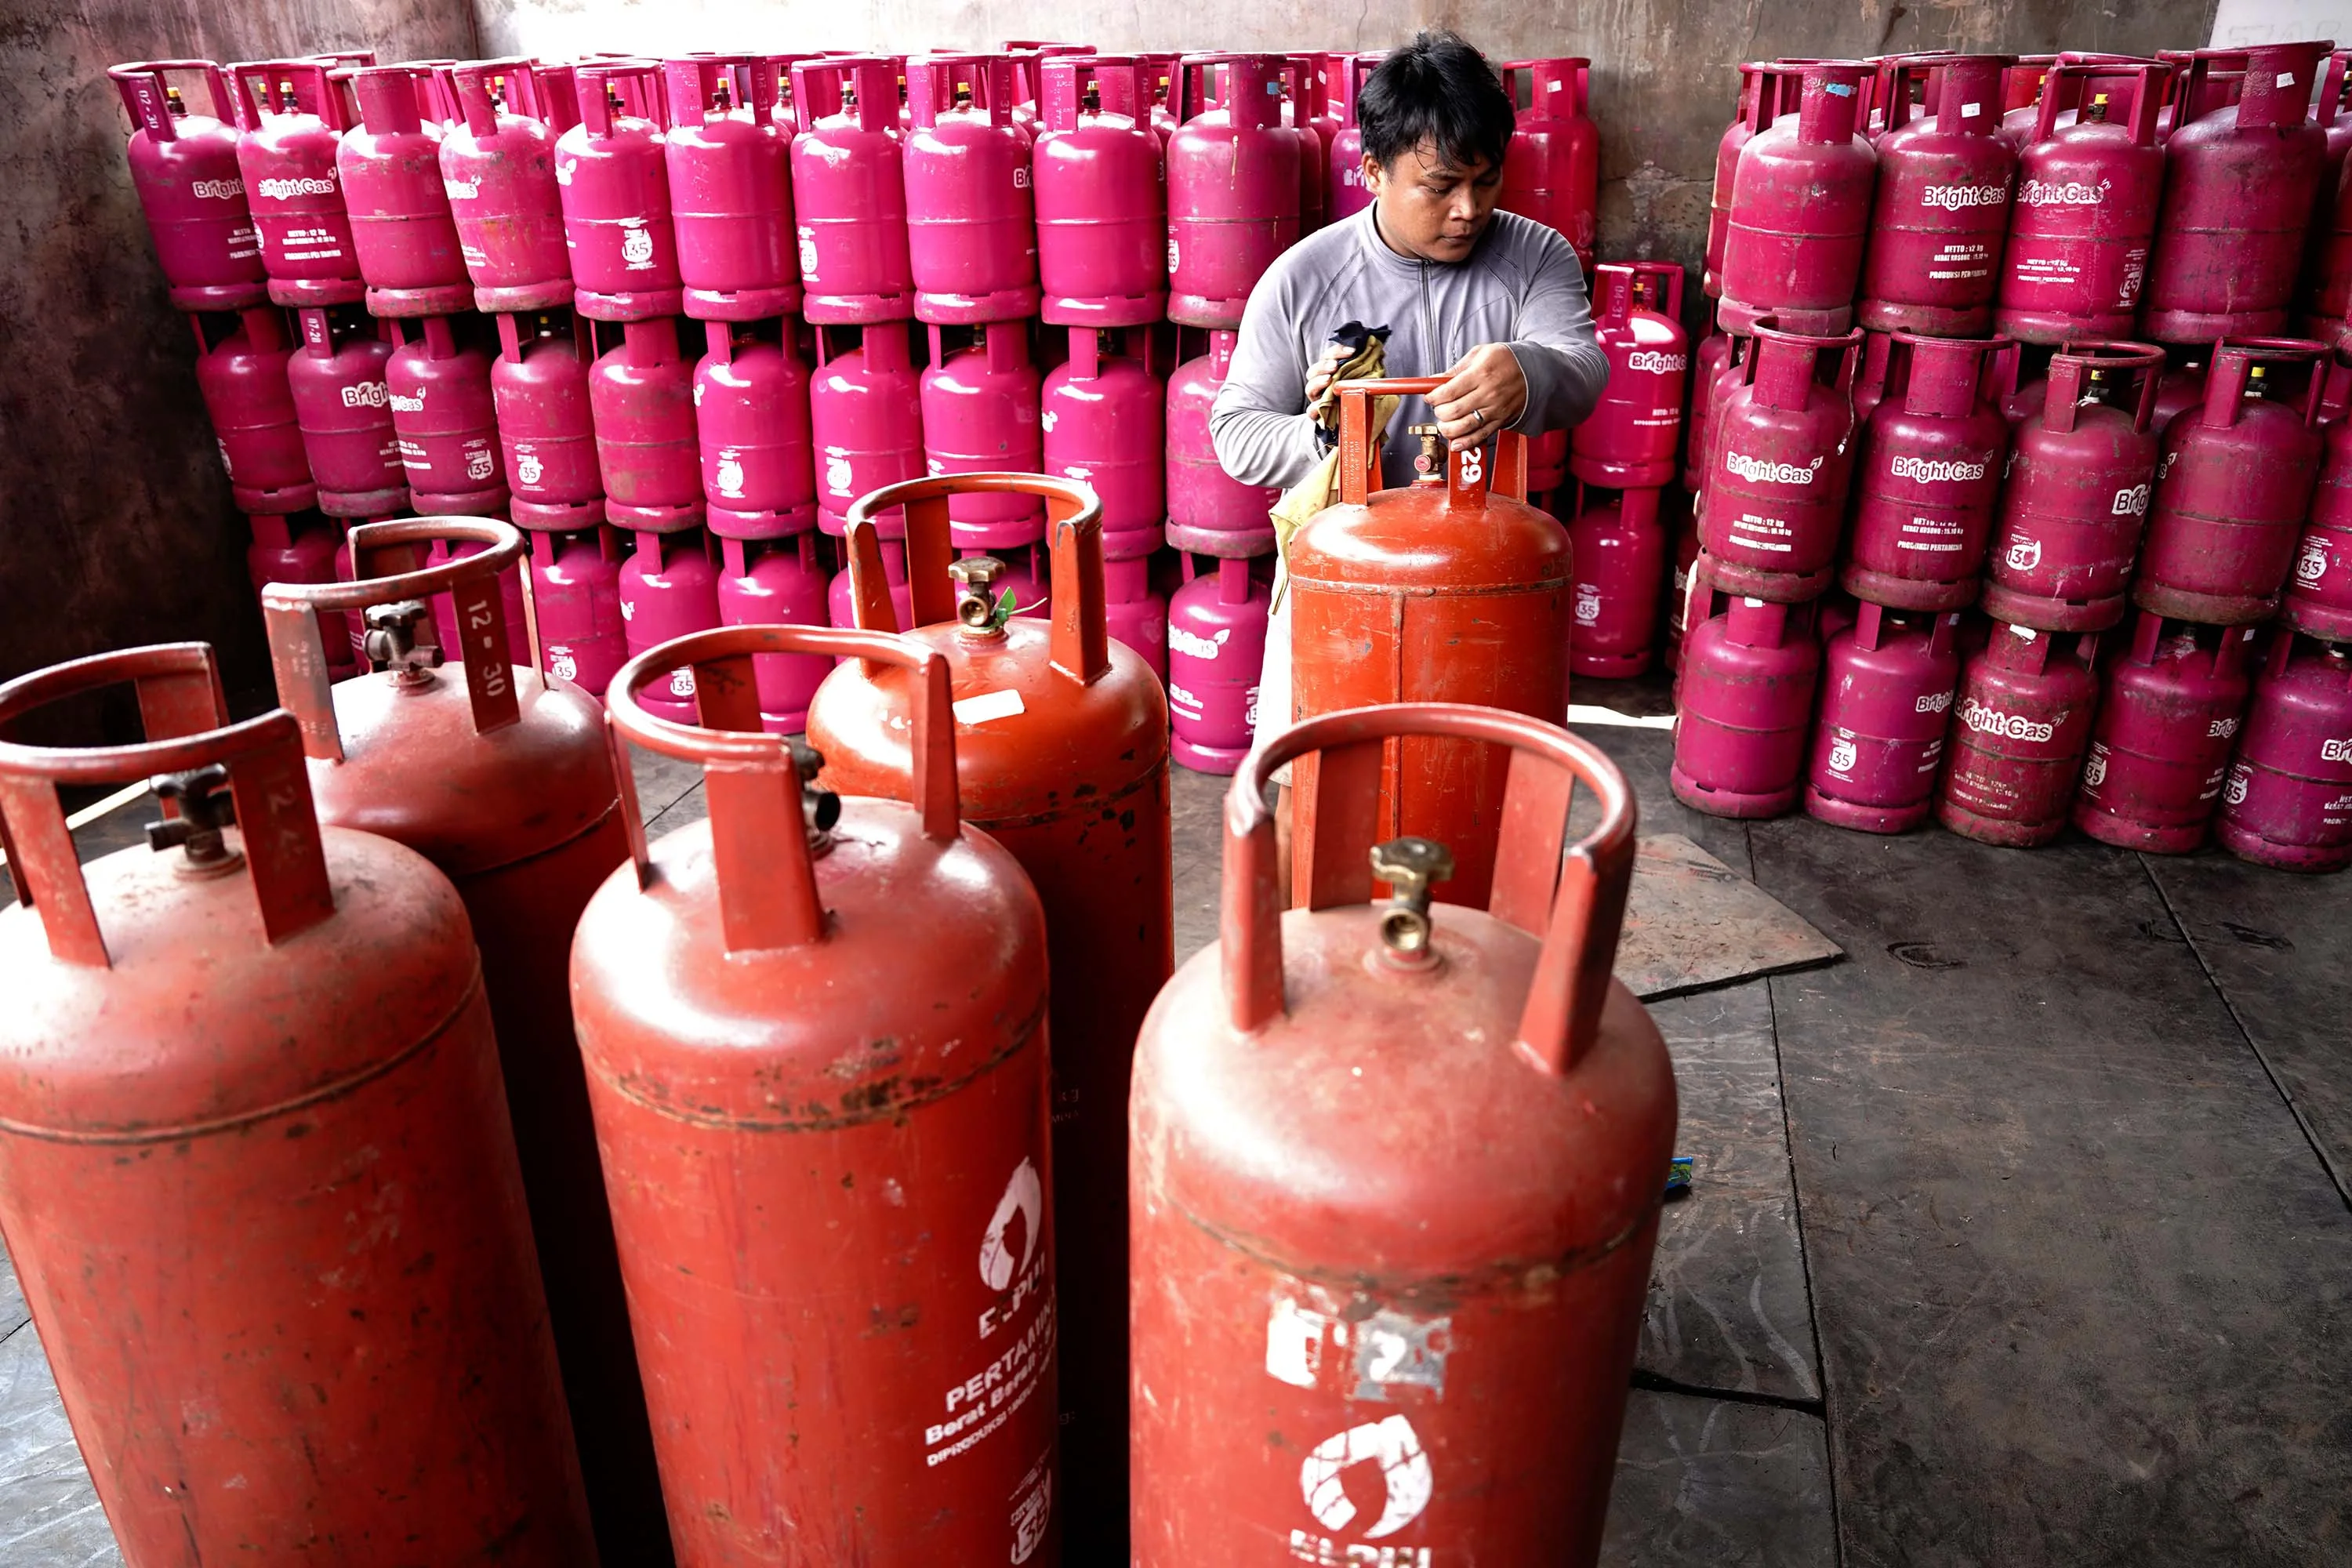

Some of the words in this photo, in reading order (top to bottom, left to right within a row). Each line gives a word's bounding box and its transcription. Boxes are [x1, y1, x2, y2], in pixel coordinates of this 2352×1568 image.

[301, 177, 335, 194] Gas
[1921, 184, 1978, 212] Bright
[1978, 185, 2005, 205] Gas
[2063, 181, 2104, 205] Gas
[1628, 351, 1678, 375] Bright
[1460, 446, 1483, 485] 29
[1726, 451, 1777, 483] Bright
[1777, 463, 1813, 485] Gas
[1890, 455, 1950, 485] Bright
[1950, 461, 1985, 481] Gas
[2297, 557, 2321, 575] 135
[671, 679, 695, 691] 135
[2005, 715, 2053, 742] Gas
[1829, 749, 1851, 768] 135
[925, 1400, 986, 1446] Berat
